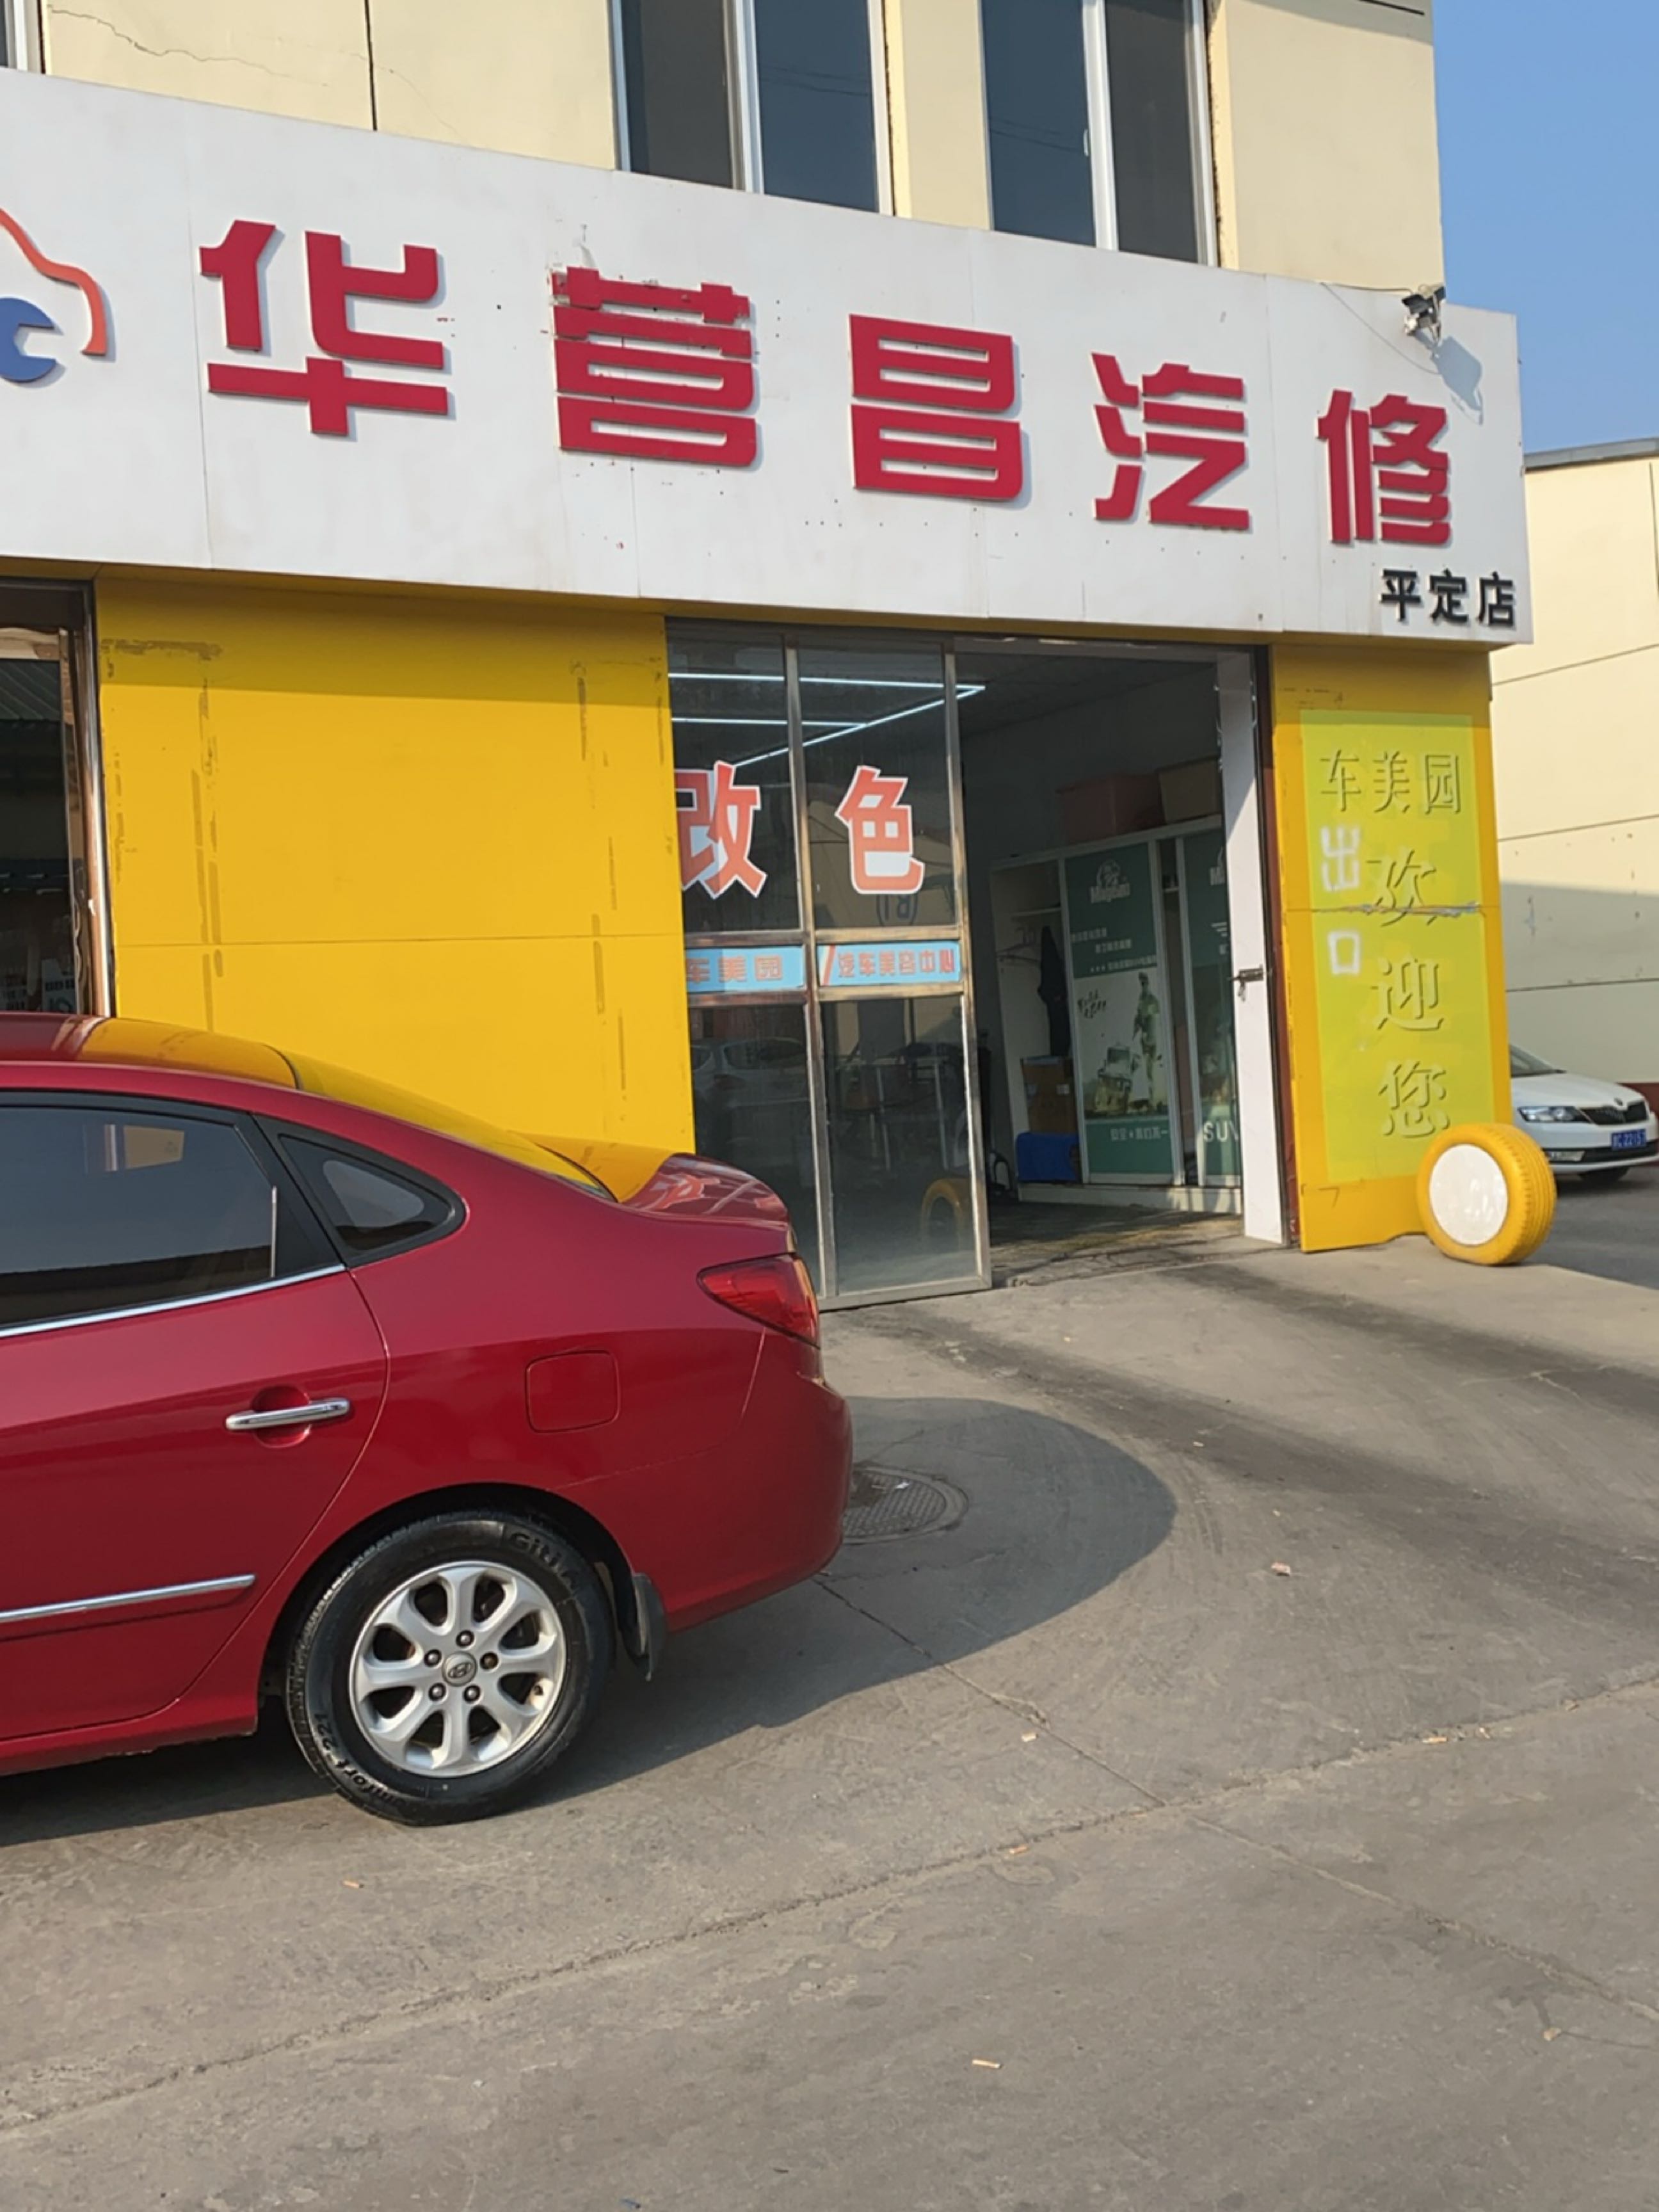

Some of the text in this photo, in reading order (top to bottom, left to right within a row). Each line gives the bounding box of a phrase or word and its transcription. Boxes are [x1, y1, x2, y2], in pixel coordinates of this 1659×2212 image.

[199, 220, 1452, 545] 华营昌汽修
[1381, 568, 1514, 627] 平定店
[674, 760, 925, 899] 改色
[1320, 749, 1461, 815] 车美园
[838, 948, 955, 978] 汽车美容中心
[1320, 824, 1363, 976] 出口
[1366, 848, 1451, 1139] 欢迎您
